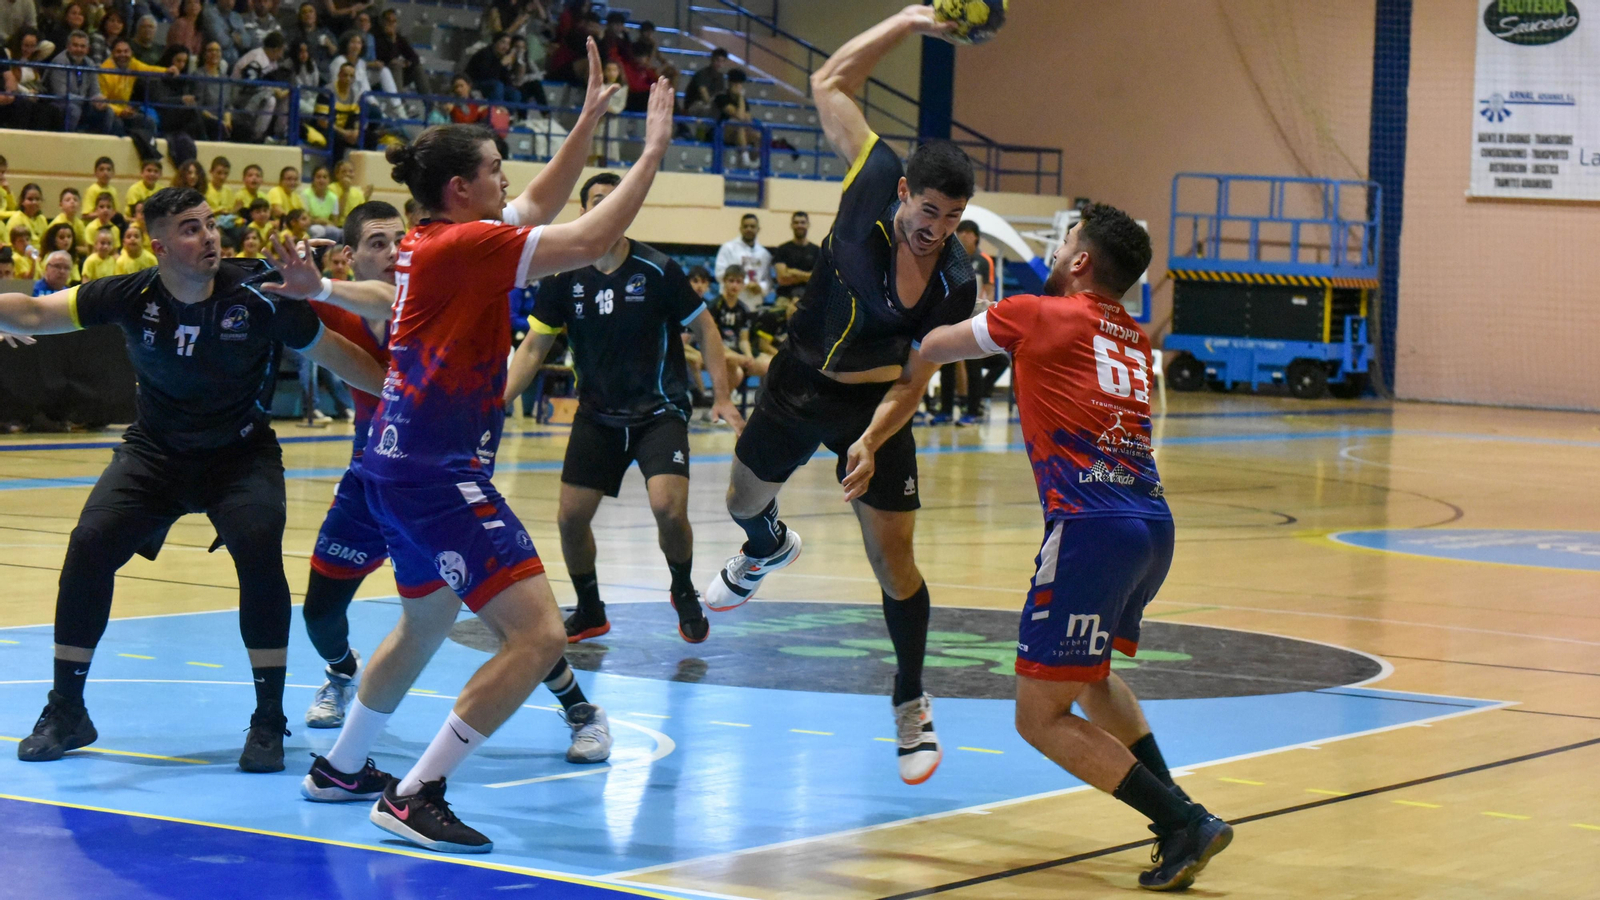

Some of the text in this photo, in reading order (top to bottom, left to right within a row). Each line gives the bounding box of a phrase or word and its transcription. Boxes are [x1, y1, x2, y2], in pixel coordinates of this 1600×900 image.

[1496, 12, 1578, 37] Saucedo
[595, 288, 614, 315] 18
[174, 324, 200, 356] 17
[1093, 334, 1149, 405] 63
[1079, 471, 1093, 484] La
[327, 542, 368, 565] BMS
[1053, 649, 1087, 657] spaces
